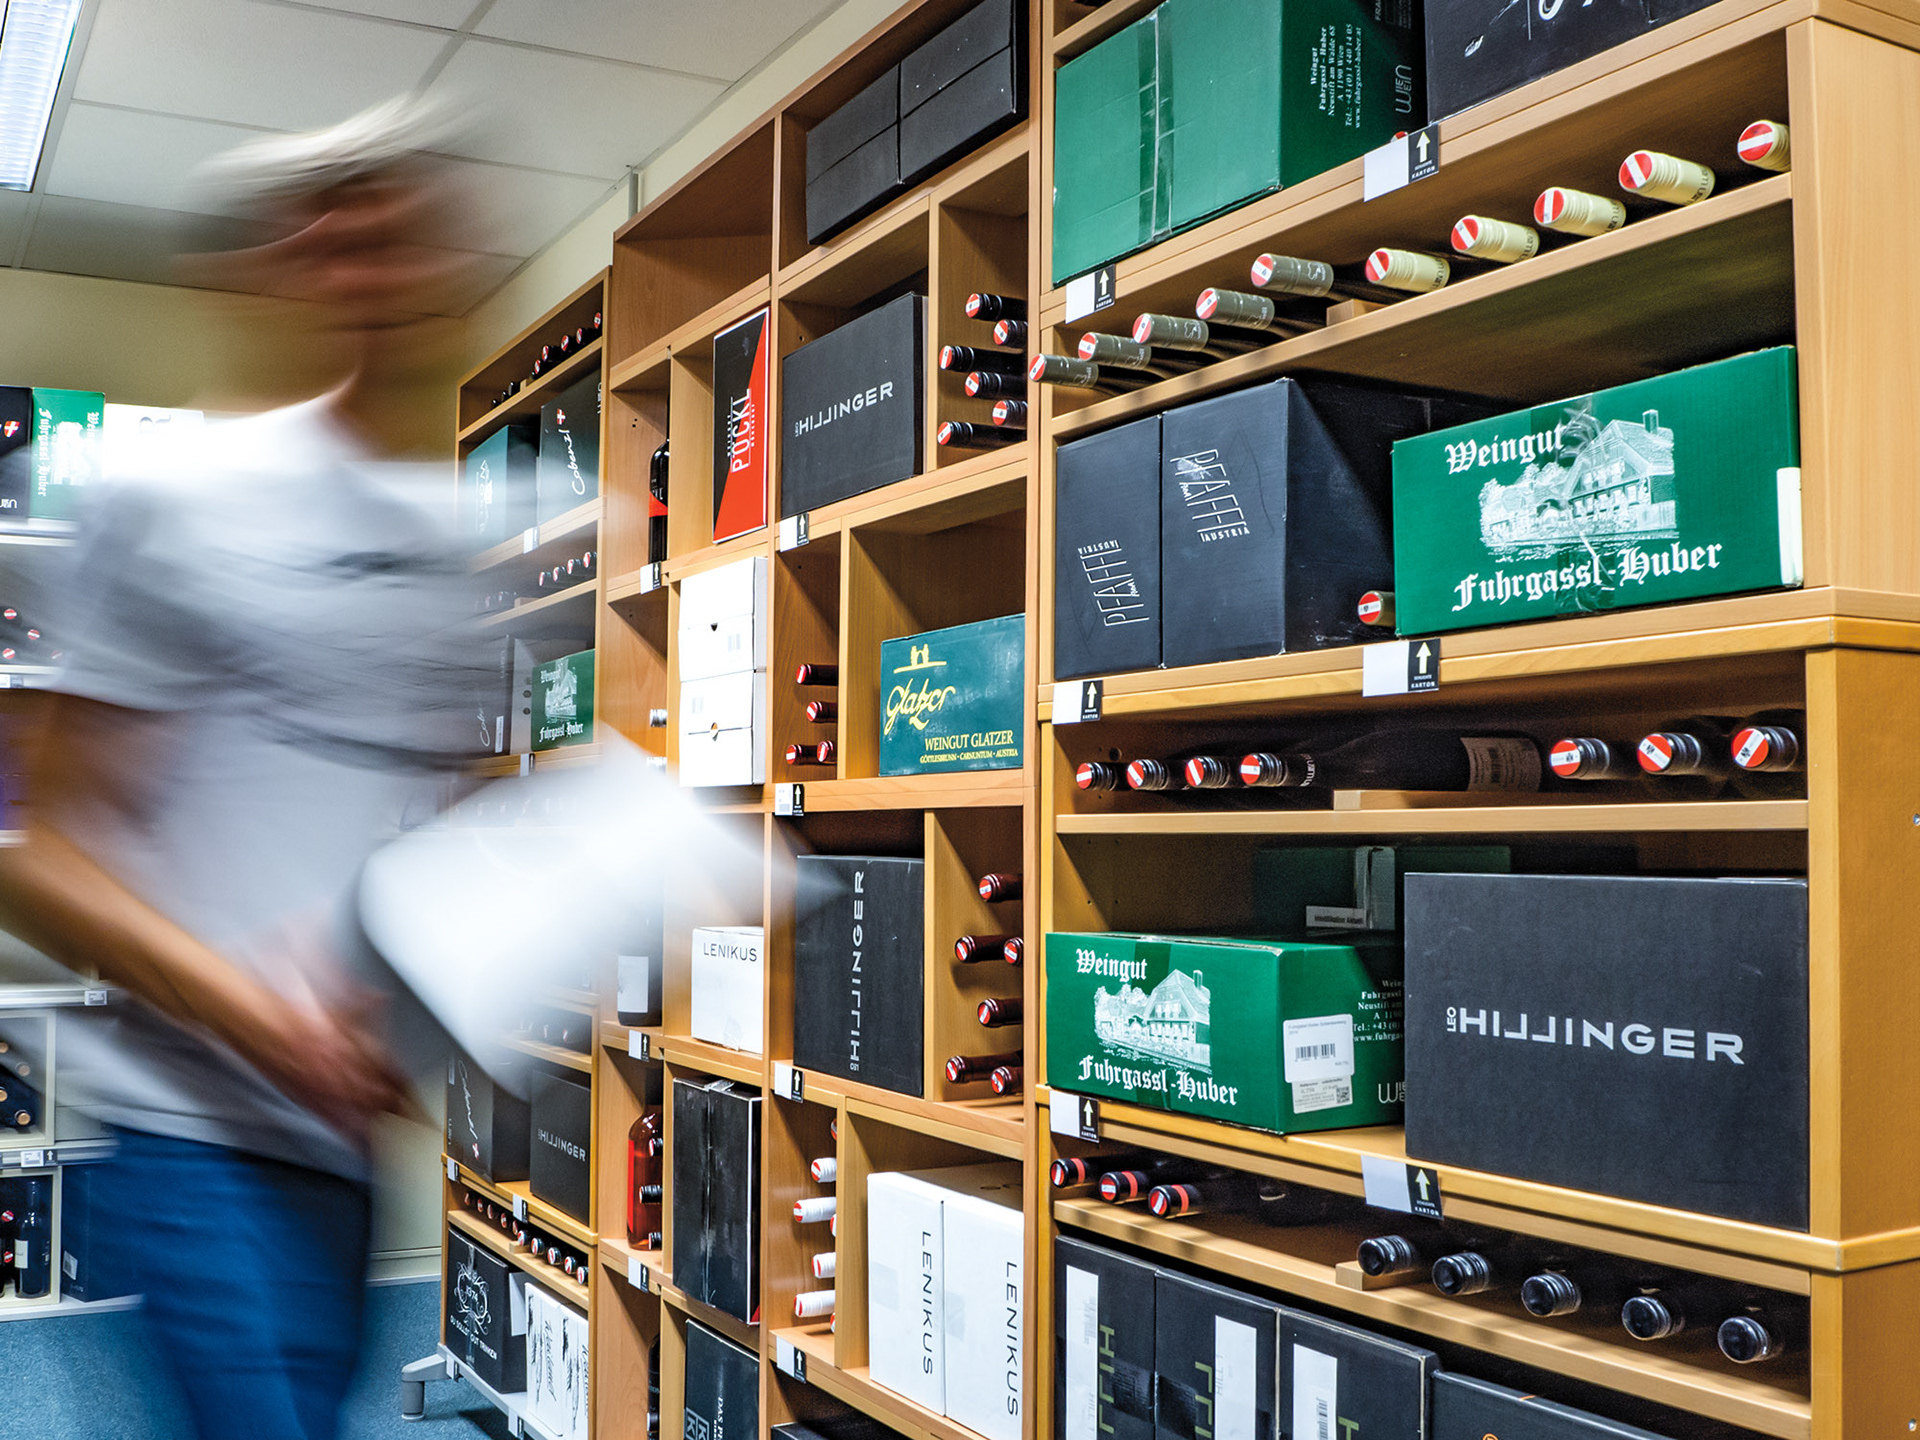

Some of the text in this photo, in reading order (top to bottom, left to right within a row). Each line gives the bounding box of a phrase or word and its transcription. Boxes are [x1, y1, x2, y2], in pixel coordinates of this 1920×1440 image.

[1319, 27, 1327, 56] Huber
[1328, 38, 1336, 64] Walde
[1346, 36, 1352, 46] 14
[1310, 47, 1318, 85] Weingut
[1330, 67, 1335, 79] am
[1319, 65, 1328, 110] Fuhrgassl
[1345, 74, 1353, 87] (0)
[1328, 81, 1336, 116] Neustift
[1411, 166, 1435, 179] KARTON
[558, 428, 585, 495] Cobenzl
[1445, 425, 1564, 475] Weingut
[1452, 542, 1723, 612] Fuhrgassl-Huber
[1411, 681, 1435, 689] KARTON
[883, 678, 956, 736] Glatzer
[924, 730, 1014, 751] WEINGUT GLATZER
[995, 748, 1018, 758] AUSTRIA
[702, 942, 758, 963] LENIKUS
[1076, 948, 1148, 982] Weingut
[1358, 1002, 1389, 1010] Neustift
[1373, 1012, 1381, 1020] A
[1372, 1022, 1387, 1030] +43
[1446, 1007, 1457, 1032] LEO
[1081, 1131, 1097, 1140] KARTON
[1414, 1206, 1440, 1216] KARTON
[921, 1230, 934, 1375] LENIKUS
[1006, 1261, 1019, 1418] LENIKUS
